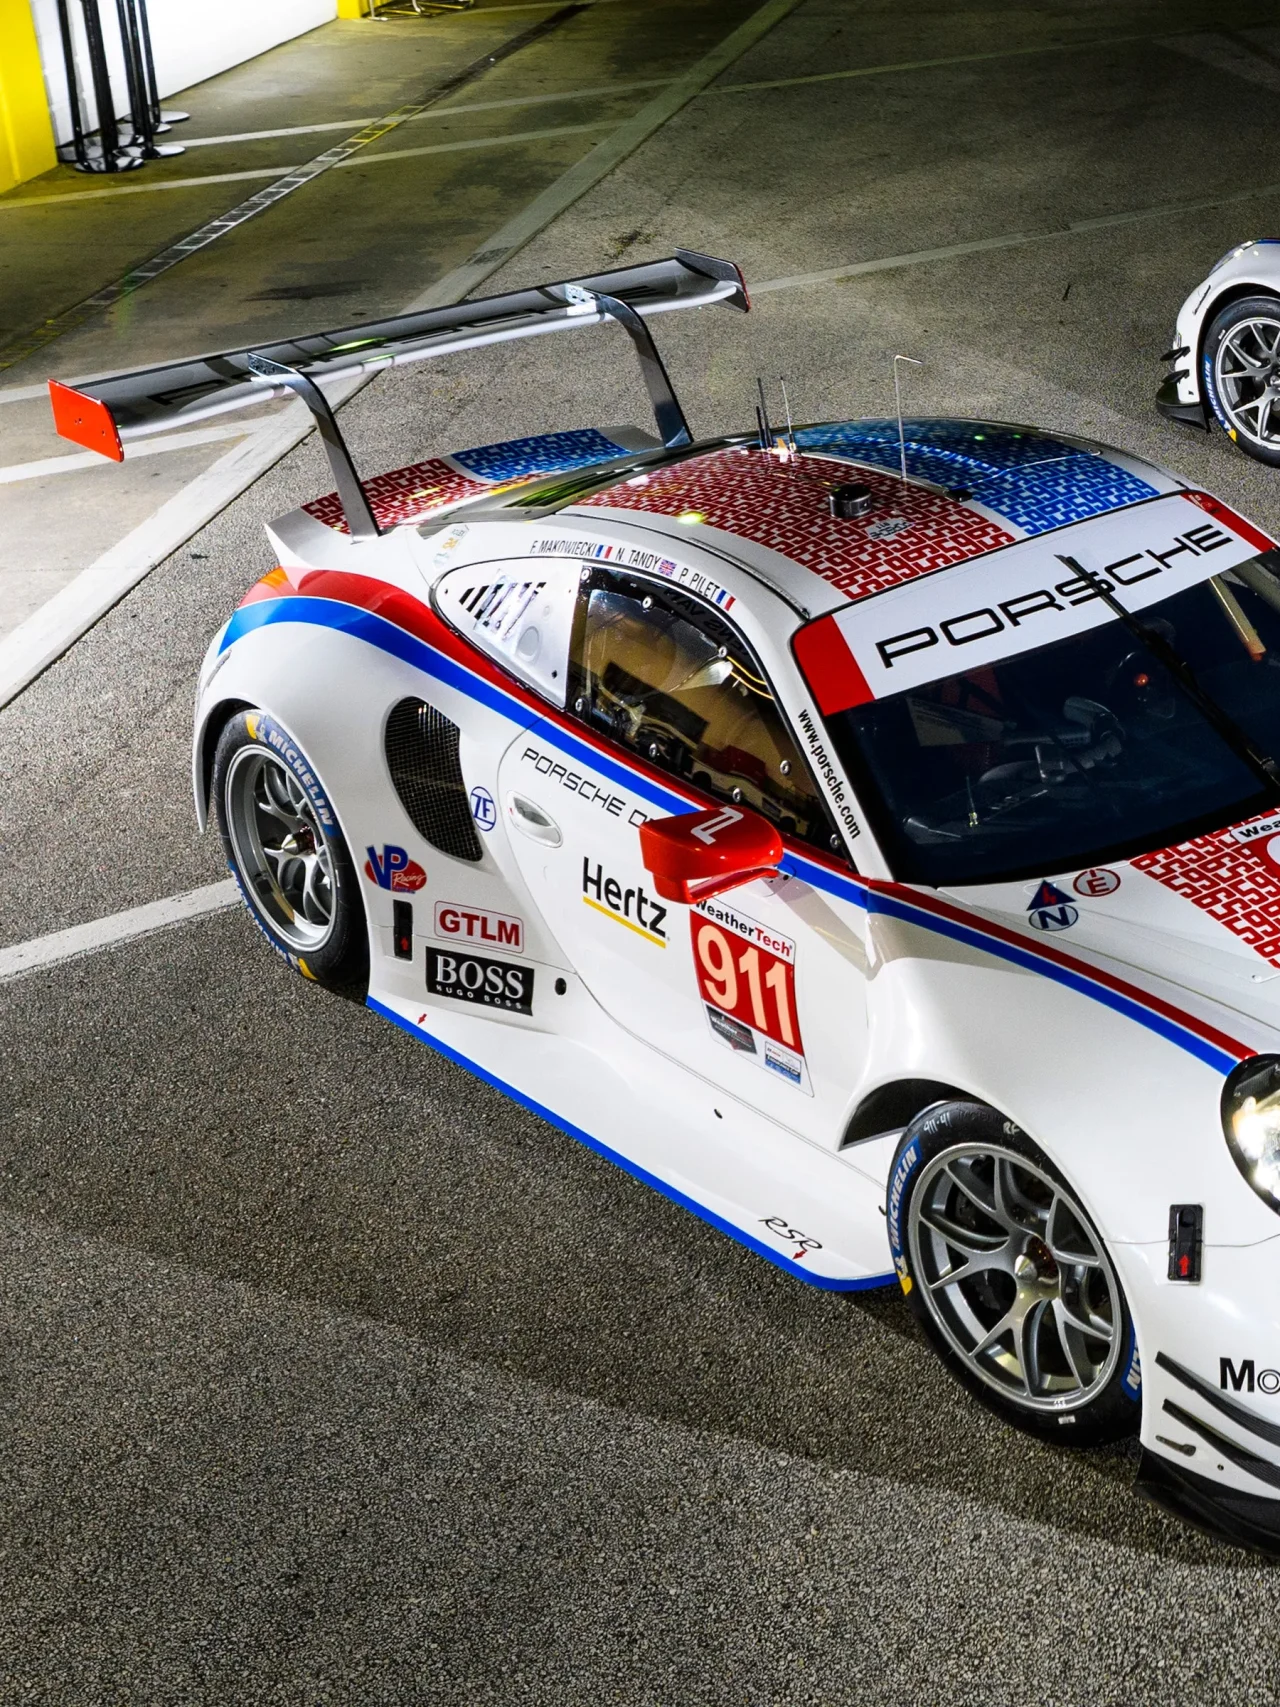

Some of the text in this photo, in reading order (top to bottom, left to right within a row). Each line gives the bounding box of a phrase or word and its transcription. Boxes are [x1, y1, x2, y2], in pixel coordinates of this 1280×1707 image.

[539, 540, 597, 557] MAKOWIECKI
[628, 549, 661, 571] TANDY
[690, 573, 721, 598] PILET
[875, 523, 1235, 669] PORSCHE
[268, 729, 335, 827] MICHELIN
[520, 747, 626, 817] PORSCHE
[798, 709, 861, 840] www.porsche.com
[365, 843, 409, 891] VP
[582, 856, 667, 939] Hertz
[438, 909, 521, 946] GTLM
[696, 900, 792, 958] WeatherTech
[435, 954, 524, 999] BOSS
[436, 984, 522, 1010] HUGO BOSS
[697, 924, 795, 1047] 911
[889, 1147, 917, 1250] MICHELIN
